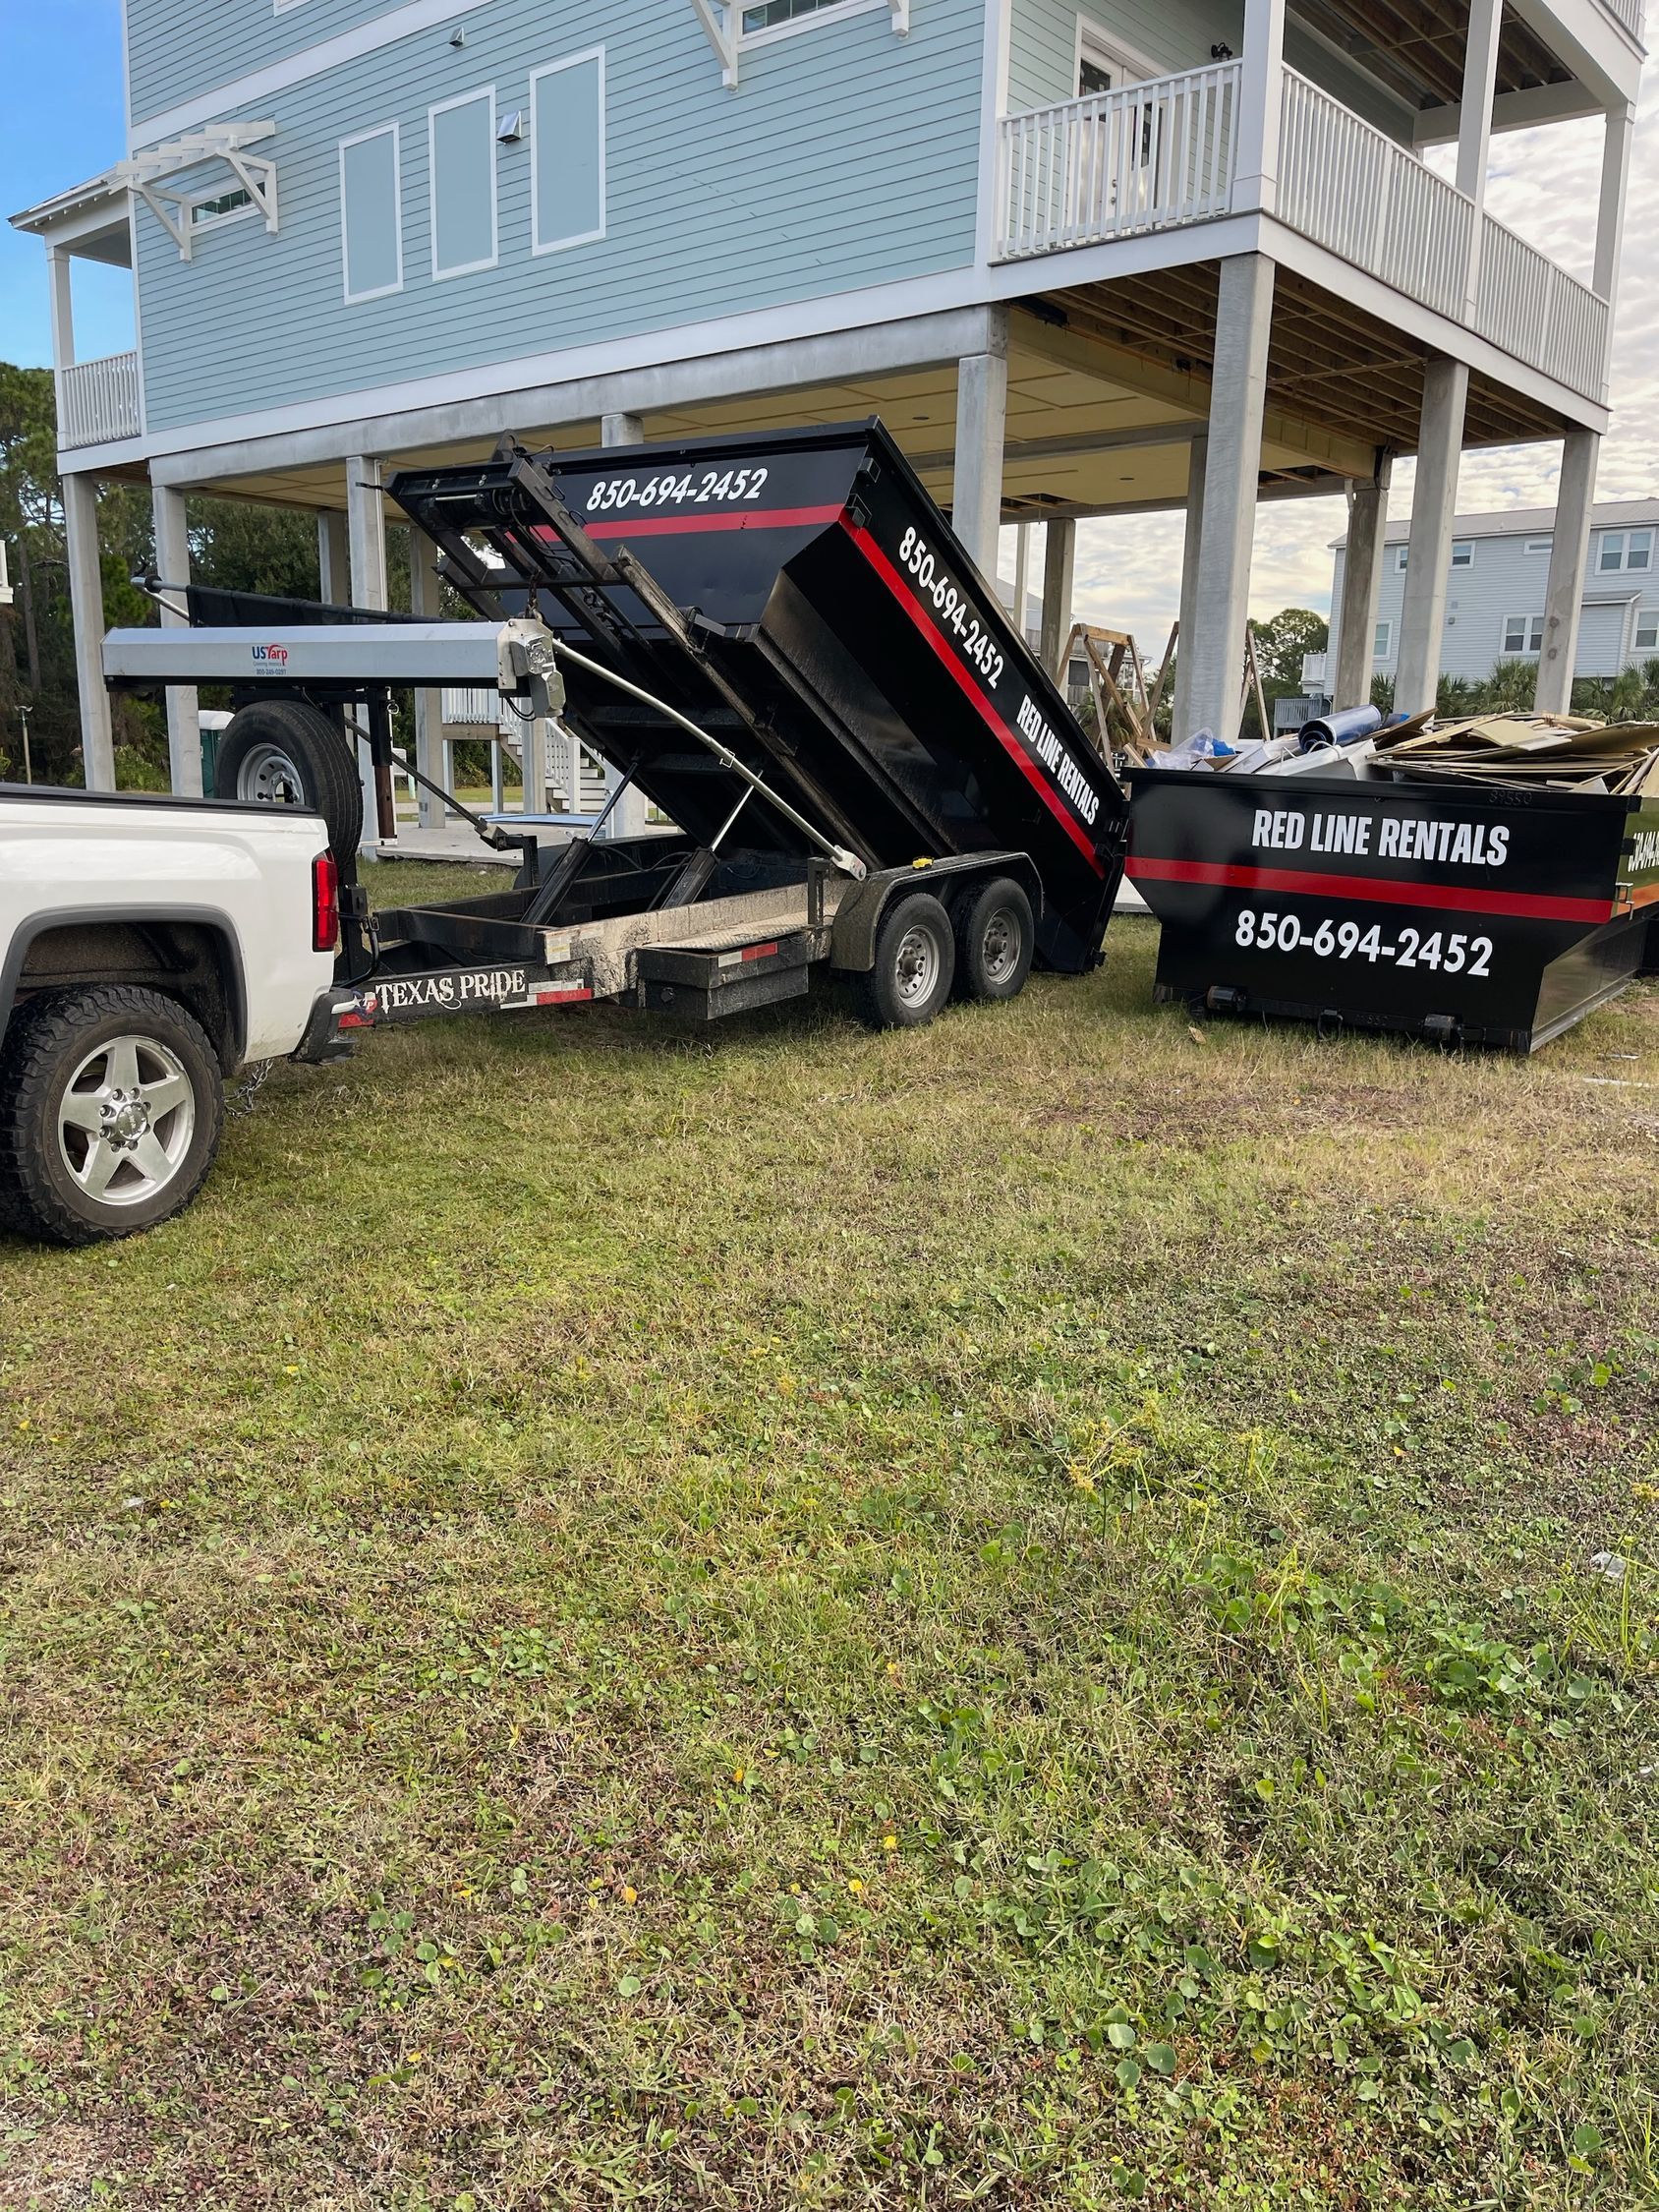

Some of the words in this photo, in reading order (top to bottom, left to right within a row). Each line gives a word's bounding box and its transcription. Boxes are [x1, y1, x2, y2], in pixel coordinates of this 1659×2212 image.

[586, 467, 769, 511] 850-694-2452
[898, 526, 1004, 689] 850-694-2452
[1016, 694, 1042, 743] RED
[1036, 723, 1062, 774] LINE
[1057, 752, 1100, 825] RENTALS
[1251, 809, 1305, 847] RED
[1310, 813, 1373, 855] LINE
[1378, 818, 1510, 866] RENTALS
[1234, 909, 1493, 977] 850-694-2452
[375, 976, 461, 1014] TEXAS
[459, 969, 525, 1003] PRIDE
